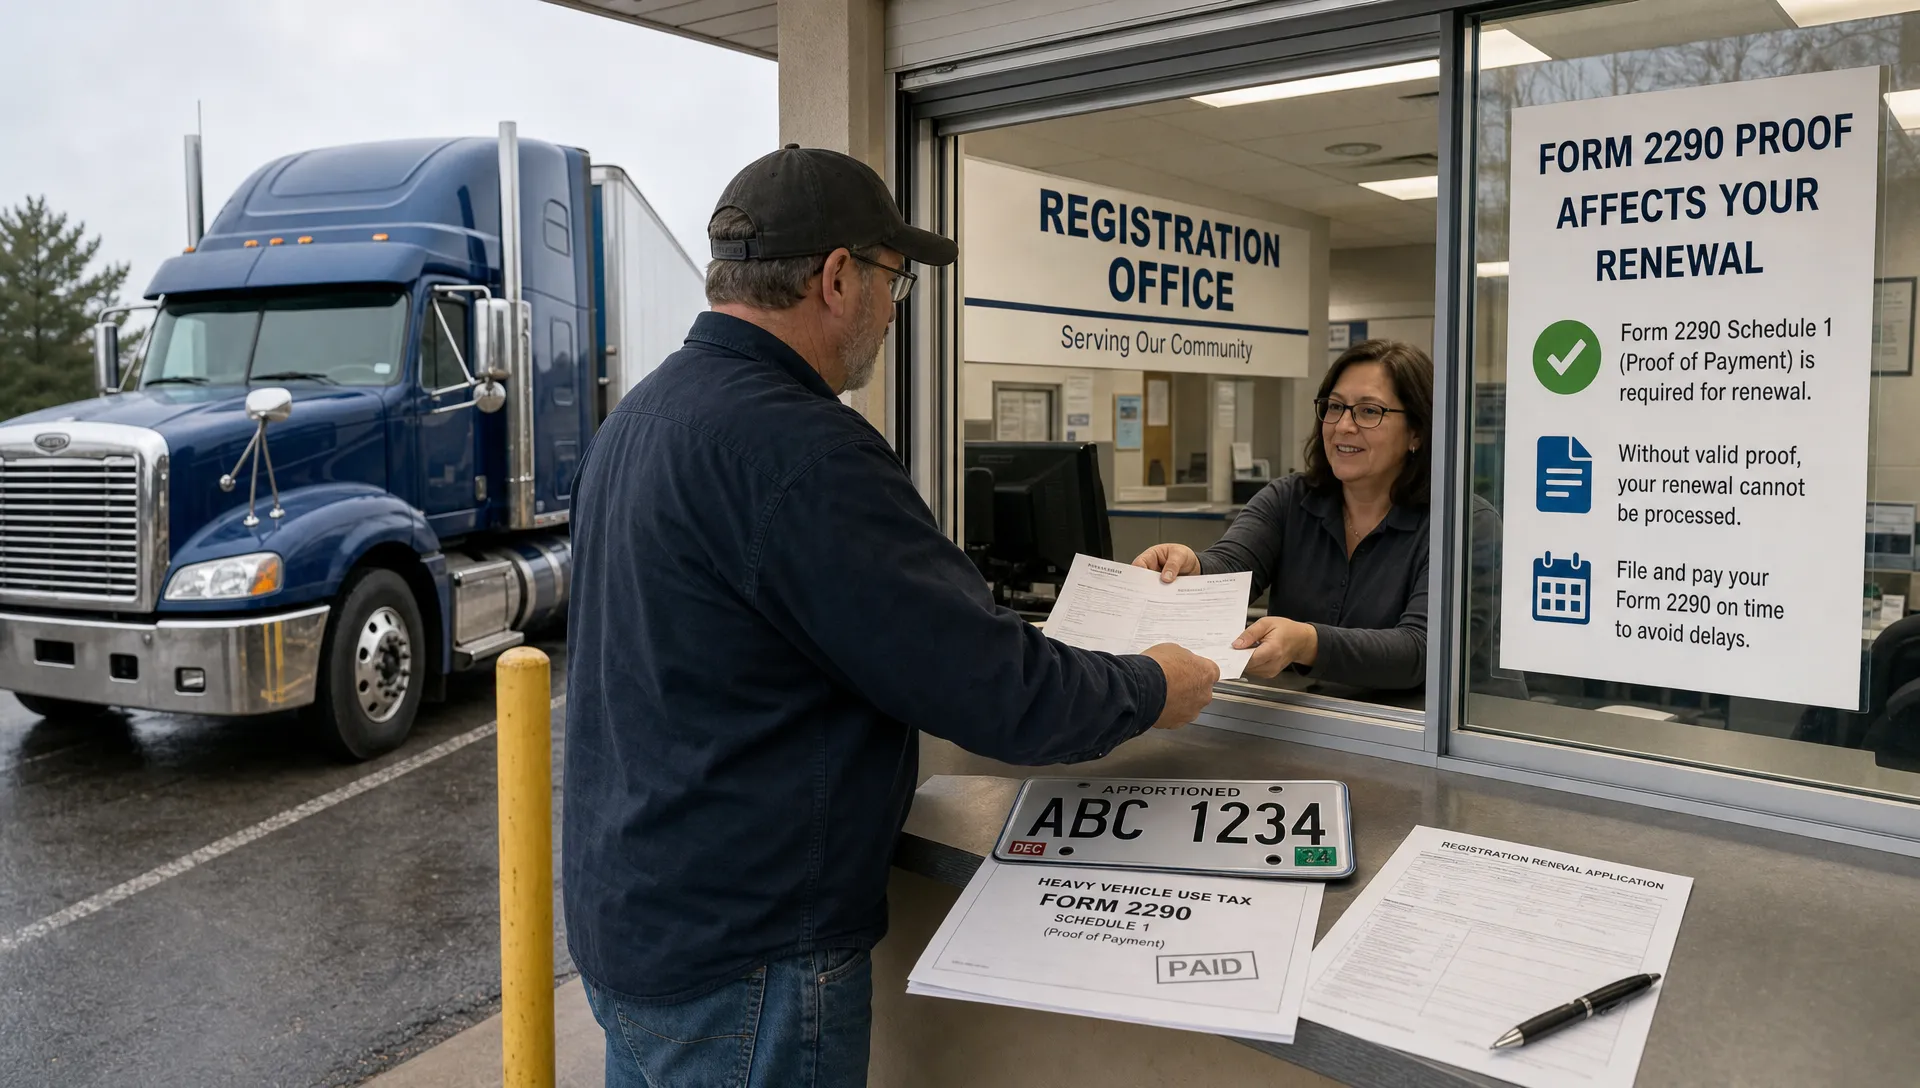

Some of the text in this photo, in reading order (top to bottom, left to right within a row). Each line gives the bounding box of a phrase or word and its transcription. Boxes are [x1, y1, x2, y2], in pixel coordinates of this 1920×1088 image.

[1540, 113, 1853, 175] FORM 2290 PROOF
[1556, 177, 1819, 229] AFFECTS YOUR
[1039, 188, 1281, 268] REGISTRATION
[1597, 241, 1763, 281] RENEWAL
[1107, 256, 1235, 312] OFFICE
[1622, 317, 1831, 341] Form 2290 Schedule 1
[1061, 325, 1253, 364] Serving Our Community
[1620, 350, 1815, 376] (Proof of Payment) is
[1620, 381, 1811, 406] required for renewal.
[1619, 444, 1801, 469] Without valid proof,
[1618, 476, 1805, 496] your renewal cannot
[1618, 503, 1741, 527] be processed.
[1618, 560, 1769, 589] File and pay your
[1617, 590, 1784, 619] Form 2290 on time
[1615, 620, 1749, 651] to avoid delays.
[1101, 784, 1241, 797] APPORTIONED
[1026, 797, 1325, 845] ABC 1234
[1012, 842, 1043, 854] DEC
[1441, 841, 1529, 863] REGISTRATION
[1585, 869, 1664, 890] APPLICATION
[1038, 878, 1252, 905] HEAVY VEHICLE USE TAX
[1040, 893, 1191, 920] FORM 2290
[1054, 914, 1149, 932] SCHEDULE 1
[1044, 927, 1165, 950] (Proof of Payment)
[1169, 958, 1242, 977] PAID
